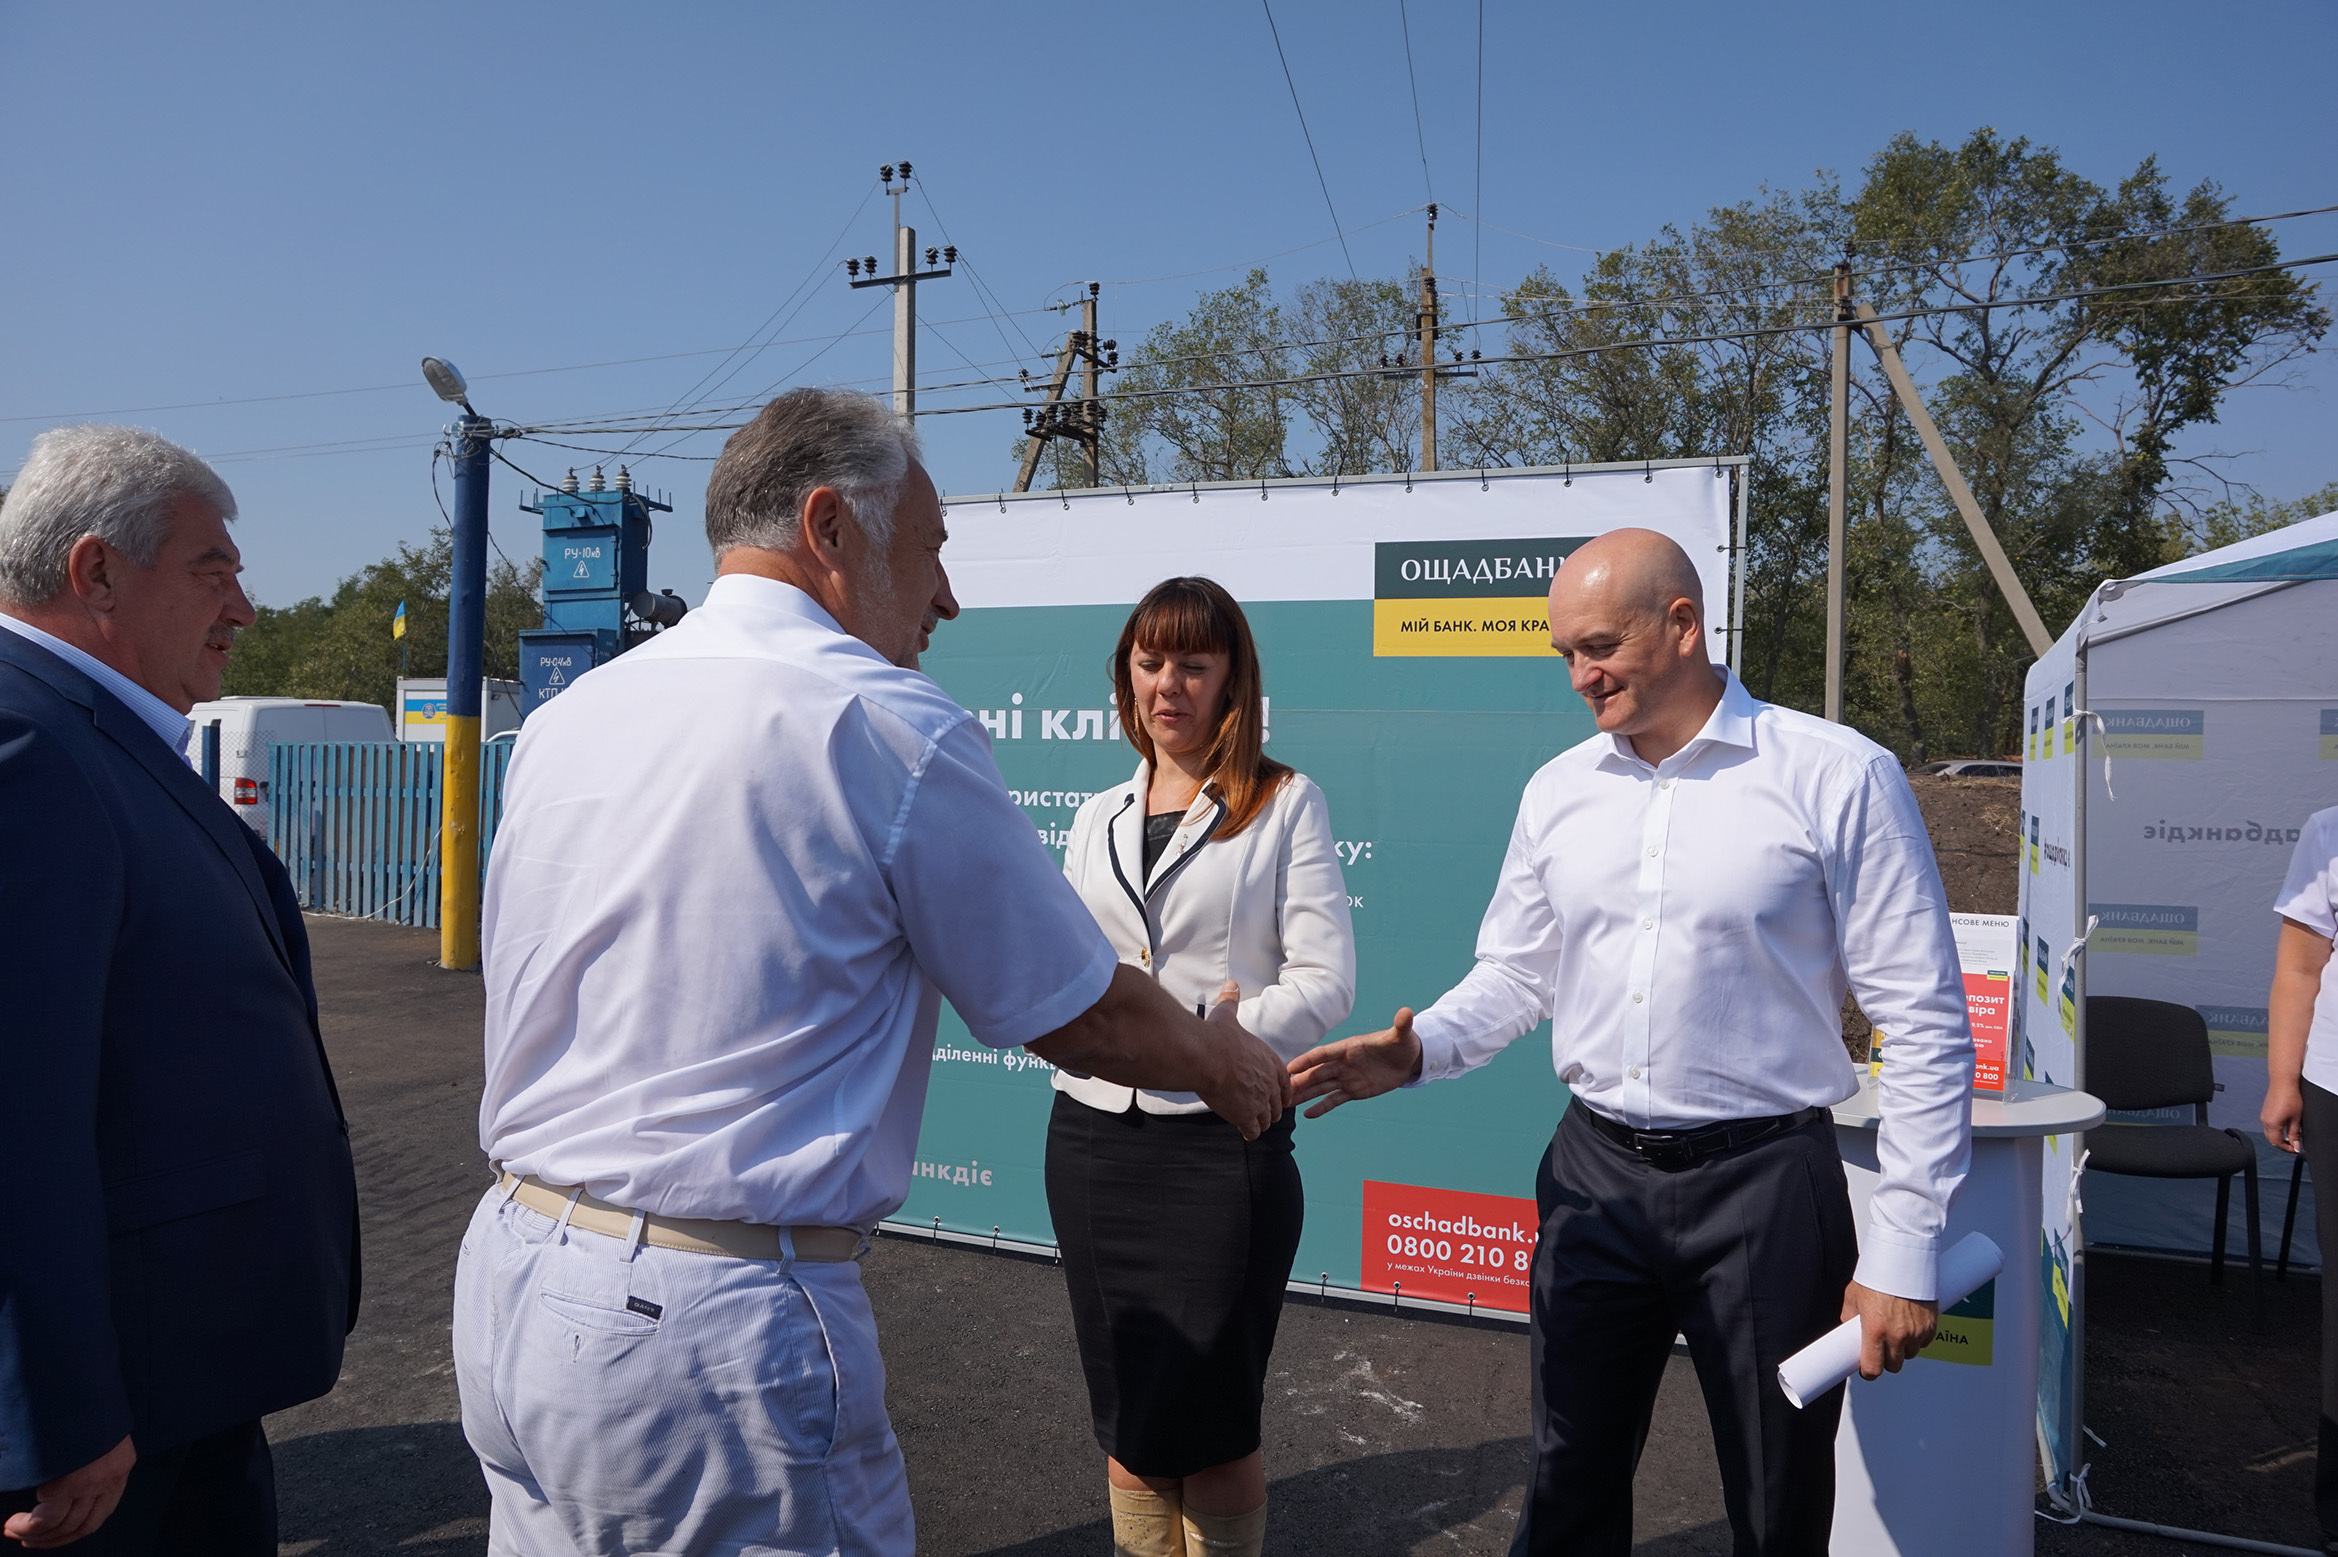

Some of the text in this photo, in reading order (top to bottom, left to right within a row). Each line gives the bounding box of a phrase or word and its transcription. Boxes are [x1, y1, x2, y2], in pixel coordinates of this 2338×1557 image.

[1401, 617, 1429, 632] МІЙ
[1434, 620, 1477, 632] БАНК.
[1482, 620, 1516, 632] МОЯ
[965, 692, 1023, 739] ні
[1968, 1004, 1996, 1017] віра
[1983, 1073, 1998, 1081] 800
[1388, 1211, 1539, 1244] oschadbank.
[1387, 1234, 1451, 1261] 0800
[1460, 1243, 1504, 1268] 210
[1387, 1262, 1393, 1270] у
[1395, 1263, 1425, 1273] межах
[1428, 1266, 1464, 1278] України
[1466, 1272, 1501, 1284] дзвінки
